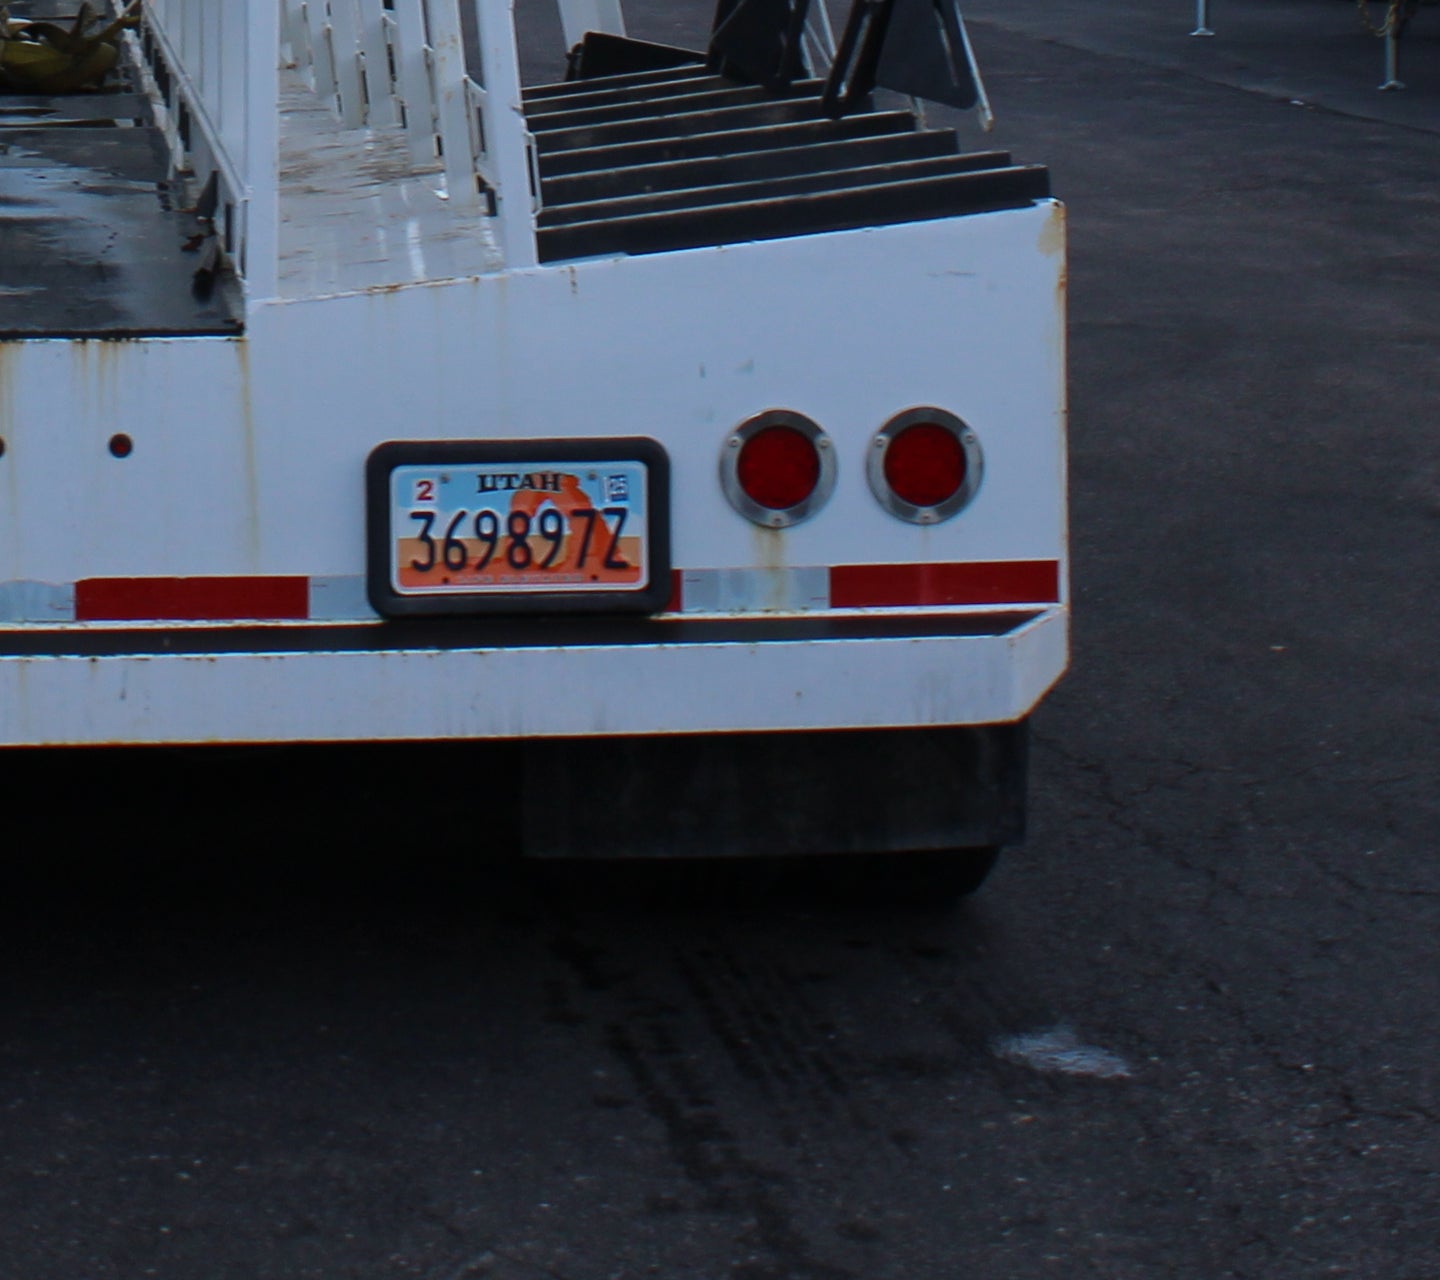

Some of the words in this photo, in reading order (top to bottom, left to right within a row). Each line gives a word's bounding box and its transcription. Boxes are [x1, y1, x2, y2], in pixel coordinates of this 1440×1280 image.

[416, 480, 435, 502] 2
[477, 472, 562, 493] UTAH
[409, 506, 630, 572] 369897Z
